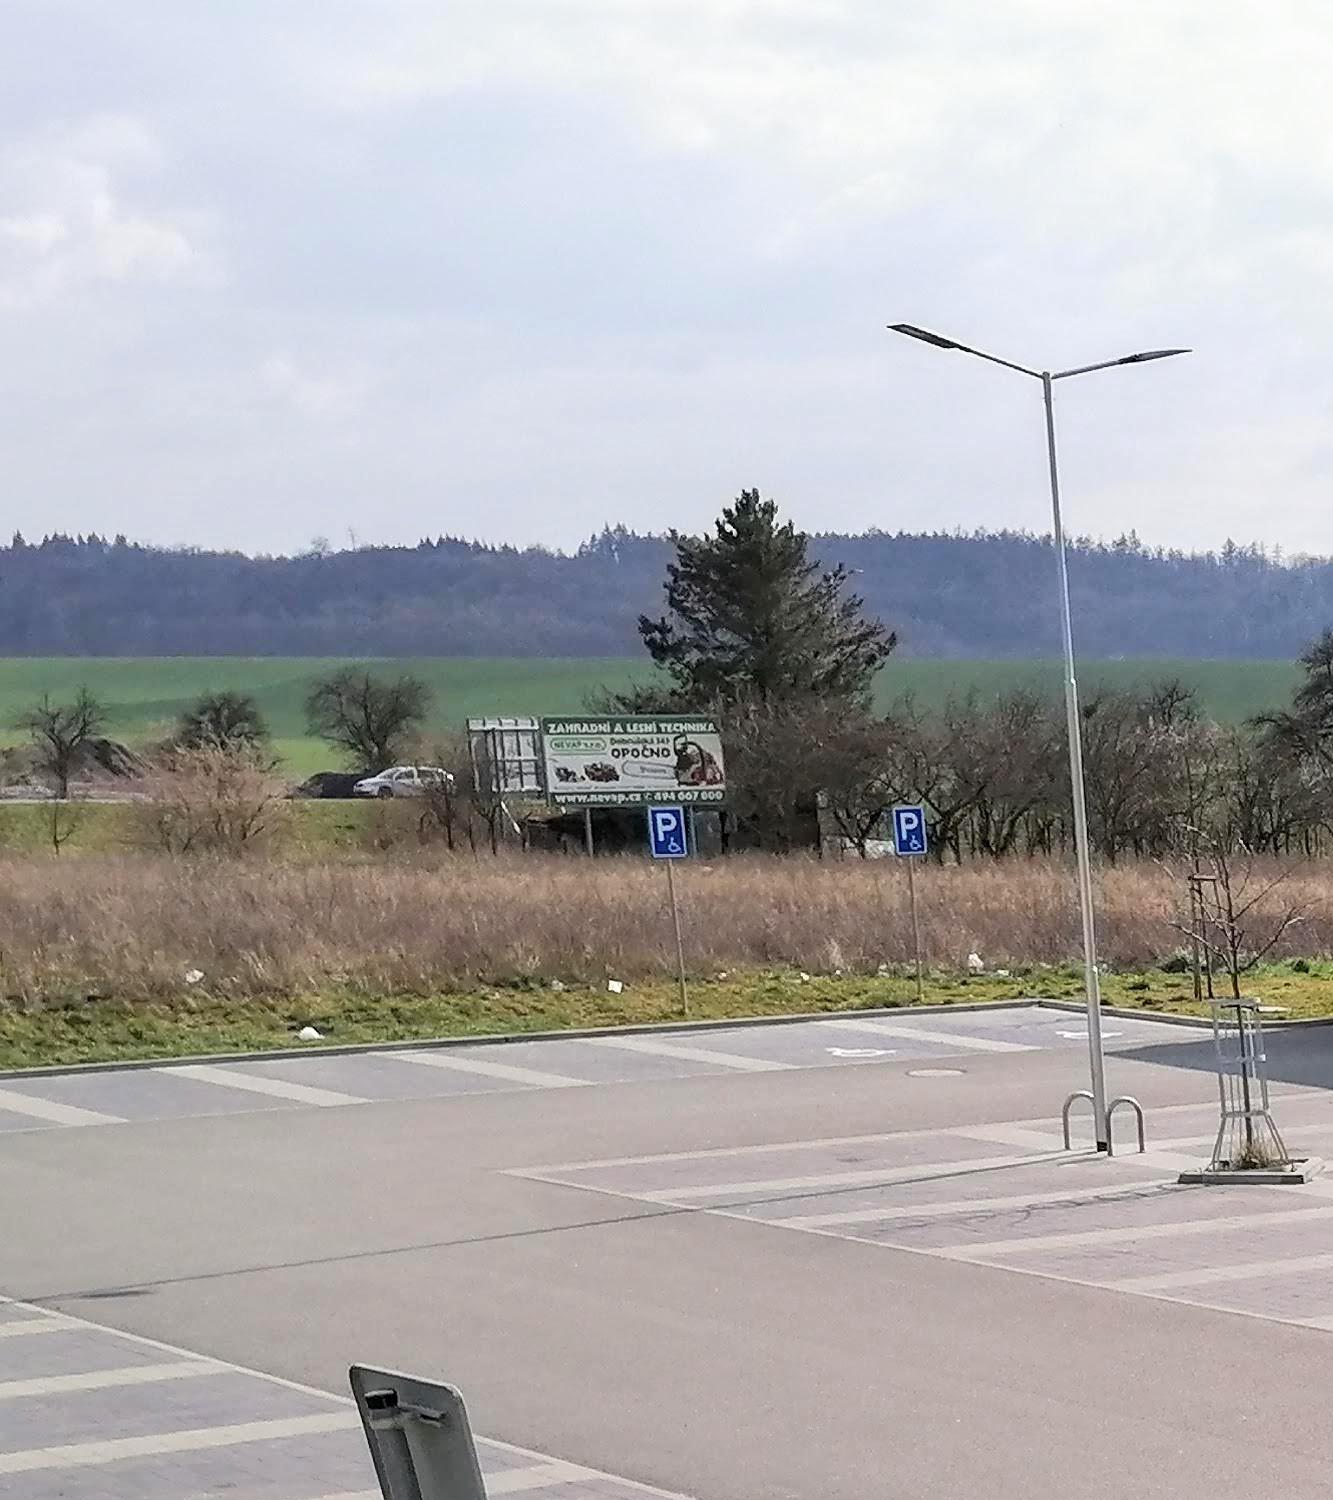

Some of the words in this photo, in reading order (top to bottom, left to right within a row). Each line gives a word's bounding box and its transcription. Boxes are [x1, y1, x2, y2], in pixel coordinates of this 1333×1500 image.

[614, 723, 625, 733] A
[659, 722, 717, 733] TECHNIKA
[611, 744, 671, 759] OPOČNO
[656, 812, 677, 842] P
[900, 812, 919, 840] P
